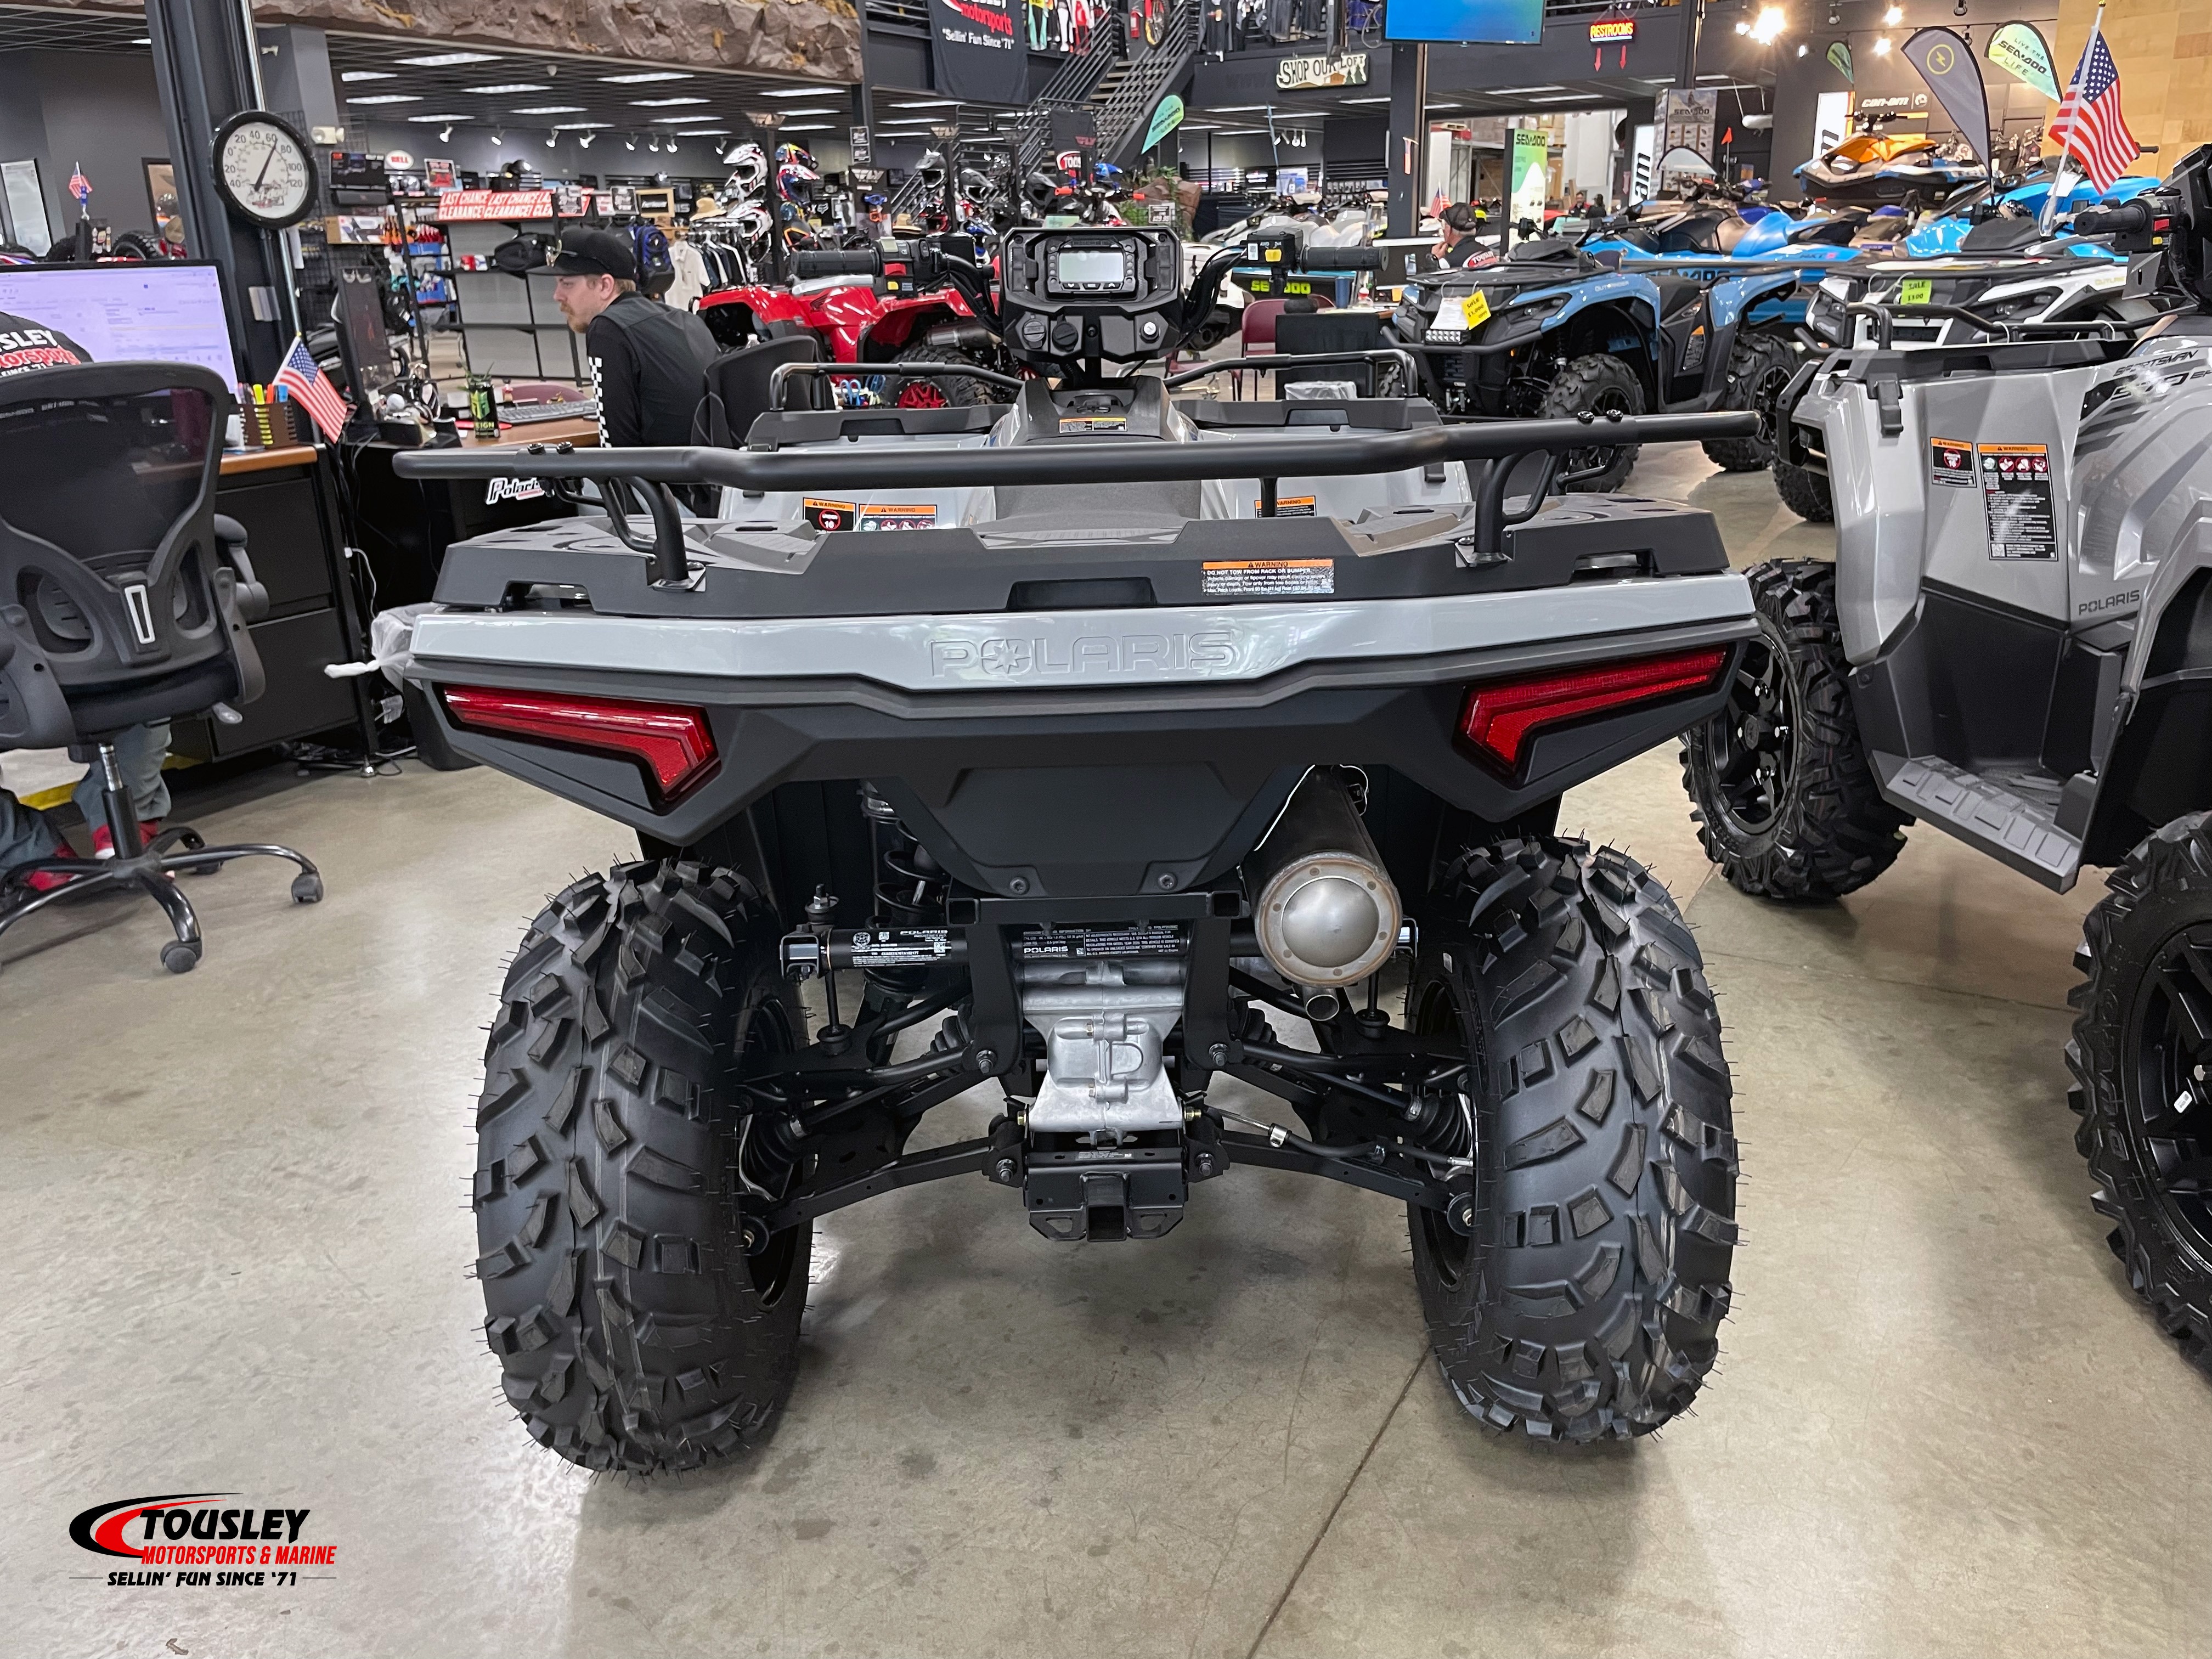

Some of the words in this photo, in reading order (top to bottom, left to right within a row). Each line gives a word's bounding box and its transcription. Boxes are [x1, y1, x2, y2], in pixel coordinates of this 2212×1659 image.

[961, 3, 1013, 36] motorsports
[1590, 22, 1633, 38] RESTROOMS
[968, 32, 983, 45] Fun
[983, 35, 1001, 48] Since
[2015, 38, 2029, 50] LIVE
[1279, 60, 1308, 85] SHOP
[1341, 56, 1363, 68] LOFT
[2004, 57, 2029, 76] LIFE
[235, 134, 246, 143] 20
[250, 131, 260, 139] 40
[266, 133, 277, 142] 60
[281, 145, 292, 154] 80
[289, 163, 302, 171] 100
[442, 193, 460, 205] LAST
[460, 191, 489, 204] CHANCE
[488, 193, 509, 205] LAST
[507, 193, 538, 204] CHANCE
[1467, 297, 1480, 308] SALE
[0, 329, 58, 352] SLEY
[2113, 350, 2199, 377] SPORTSMAN
[2079, 590, 2140, 615] POLARIS
[930, 631, 1235, 677] POLARIS
